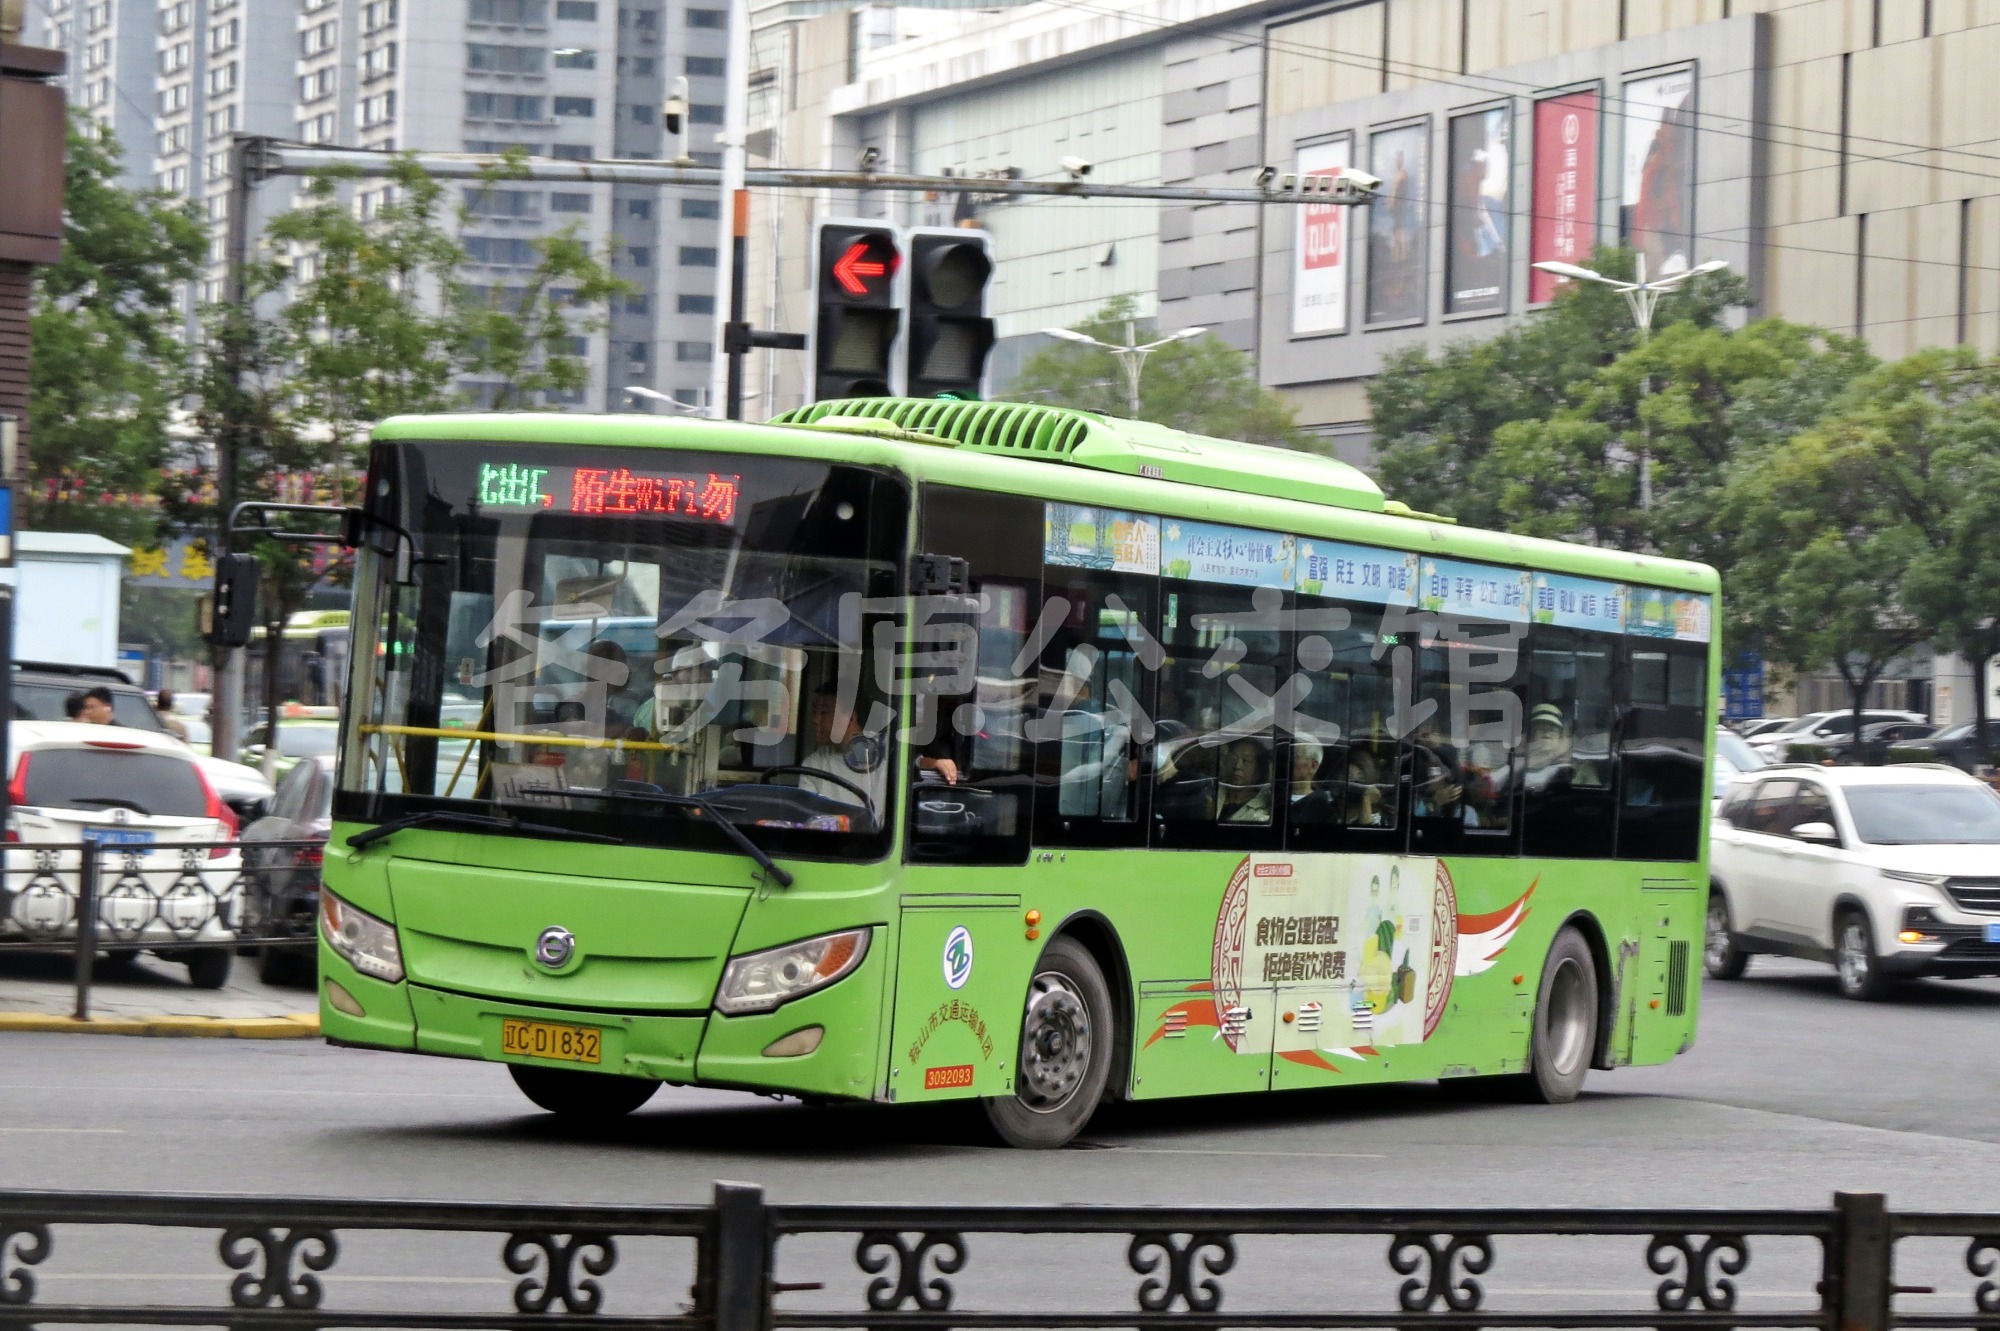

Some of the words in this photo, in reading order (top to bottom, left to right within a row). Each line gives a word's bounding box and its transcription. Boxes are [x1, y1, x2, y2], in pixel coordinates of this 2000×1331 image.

[1187, 534, 1274, 565] 社会主义核心价值观
[1309, 555, 1329, 581] 富强
[1336, 559, 1354, 584] 民主
[1361, 562, 1381, 588] 文明
[1256, 916, 1340, 947] 食物合理搭配
[1263, 951, 1347, 982] 拒绝餐饮浪费
[927, 1068, 972, 1086] 3092093
